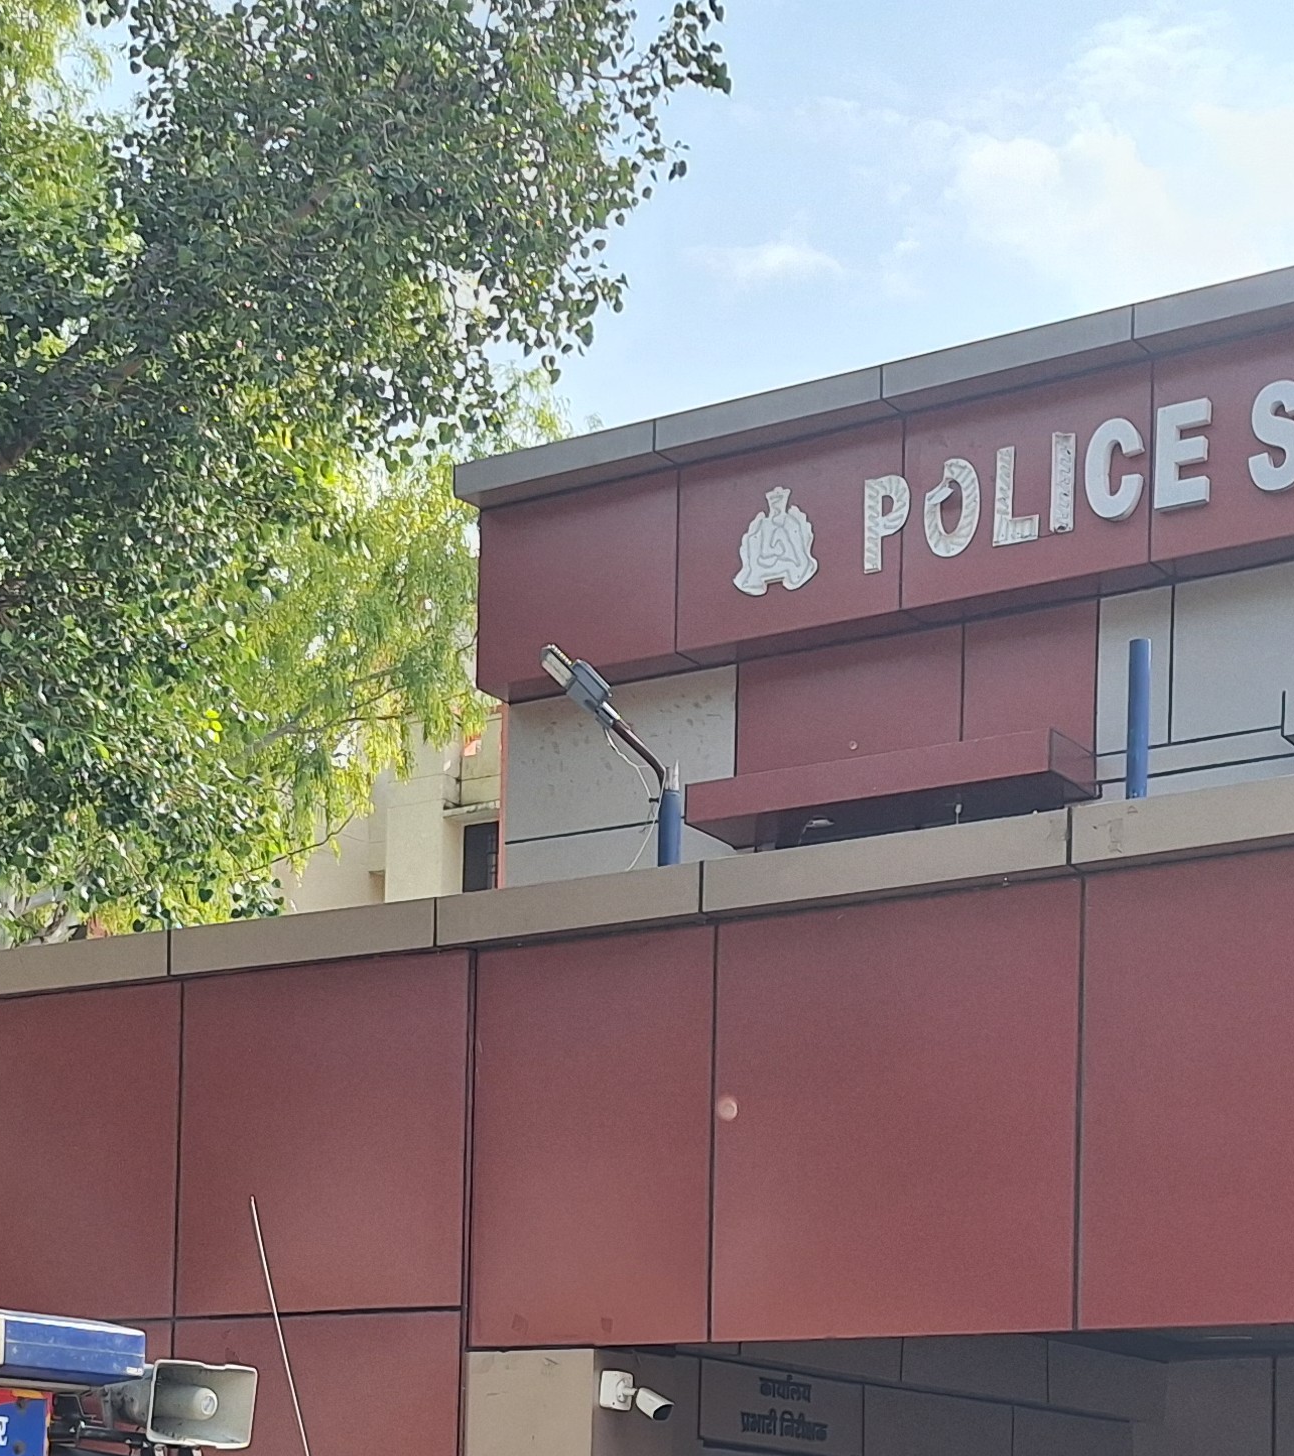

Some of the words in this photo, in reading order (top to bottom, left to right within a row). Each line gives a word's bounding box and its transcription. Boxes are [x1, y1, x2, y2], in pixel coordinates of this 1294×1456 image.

[863, 397, 1213, 574] POLICE
[759, 1374, 812, 1404] कार्यालय
[741, 1408, 778, 1436] प्रभारी
